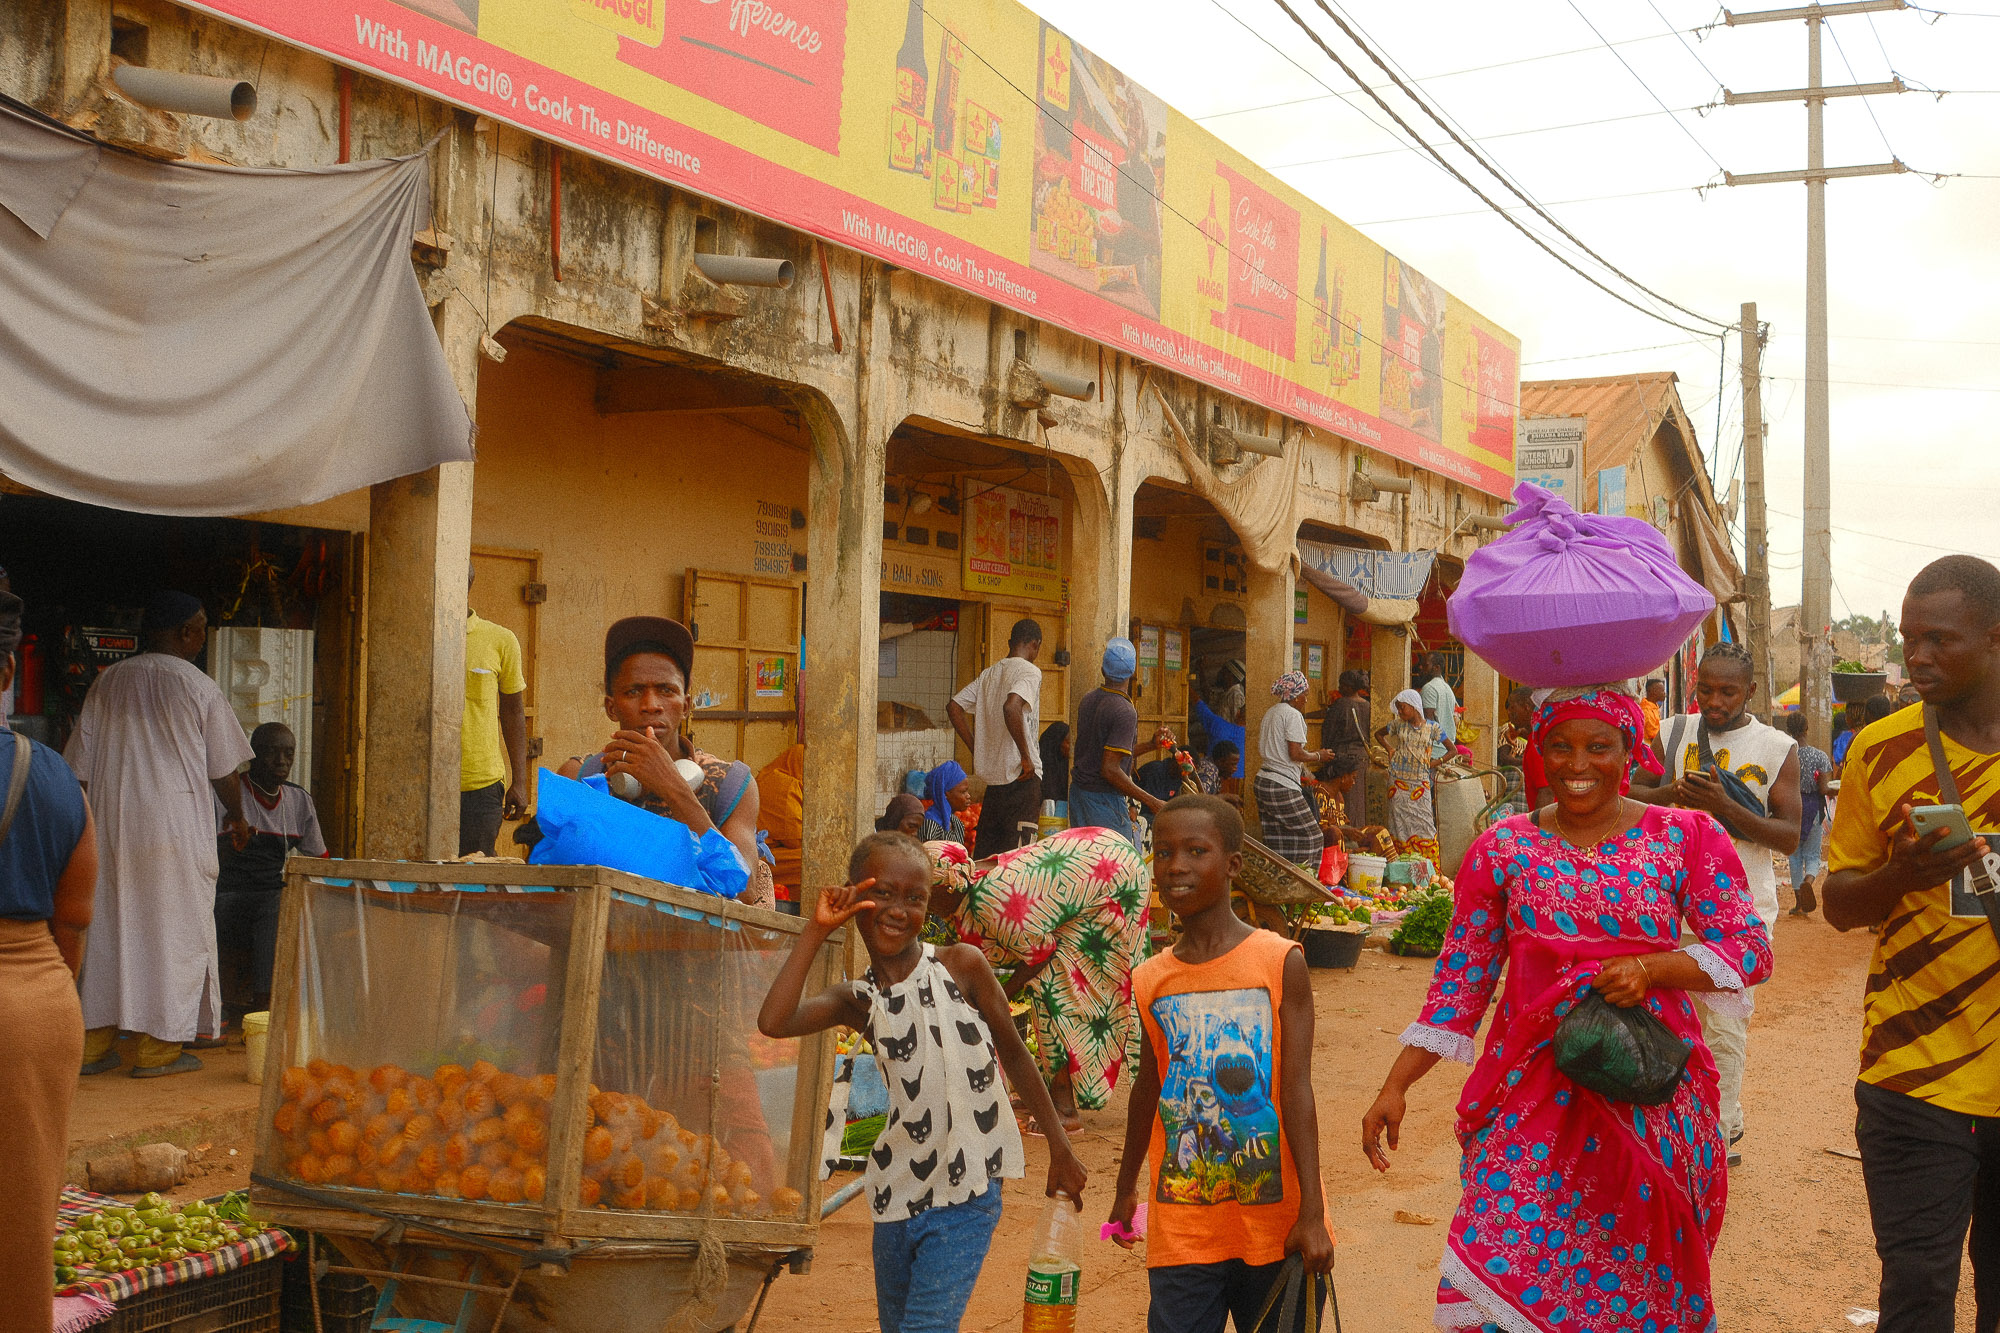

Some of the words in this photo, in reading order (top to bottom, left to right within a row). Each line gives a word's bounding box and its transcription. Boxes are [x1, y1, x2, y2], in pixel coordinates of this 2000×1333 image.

[582, 0, 653, 28] GGI
[355, 14, 409, 62] With
[524, 84, 573, 126] Cook
[579, 104, 611, 139] The
[616, 119, 701, 175] Difference
[1095, 173, 1114, 207] STAR
[1235, 196, 1261, 241] Cook
[1262, 220, 1277, 250] the
[842, 209, 871, 240] With
[934, 247, 963, 275] Cook
[966, 258, 984, 283] The
[987, 268, 1037, 304] Difference
[1240, 243, 1289, 300] Difference
[1197, 275, 1224, 302] MAGGI
[1122, 322, 1140, 344] With
[1178, 347, 1195, 367] Cook
[1196, 354, 1208, 373] The
[1210, 360, 1241, 385] Difference
[1295, 396, 1308, 413] With
[971, 559, 991, 572] INFANT
[991, 563, 1009, 575] CEREAL
[99, 637, 134, 648] POWER
